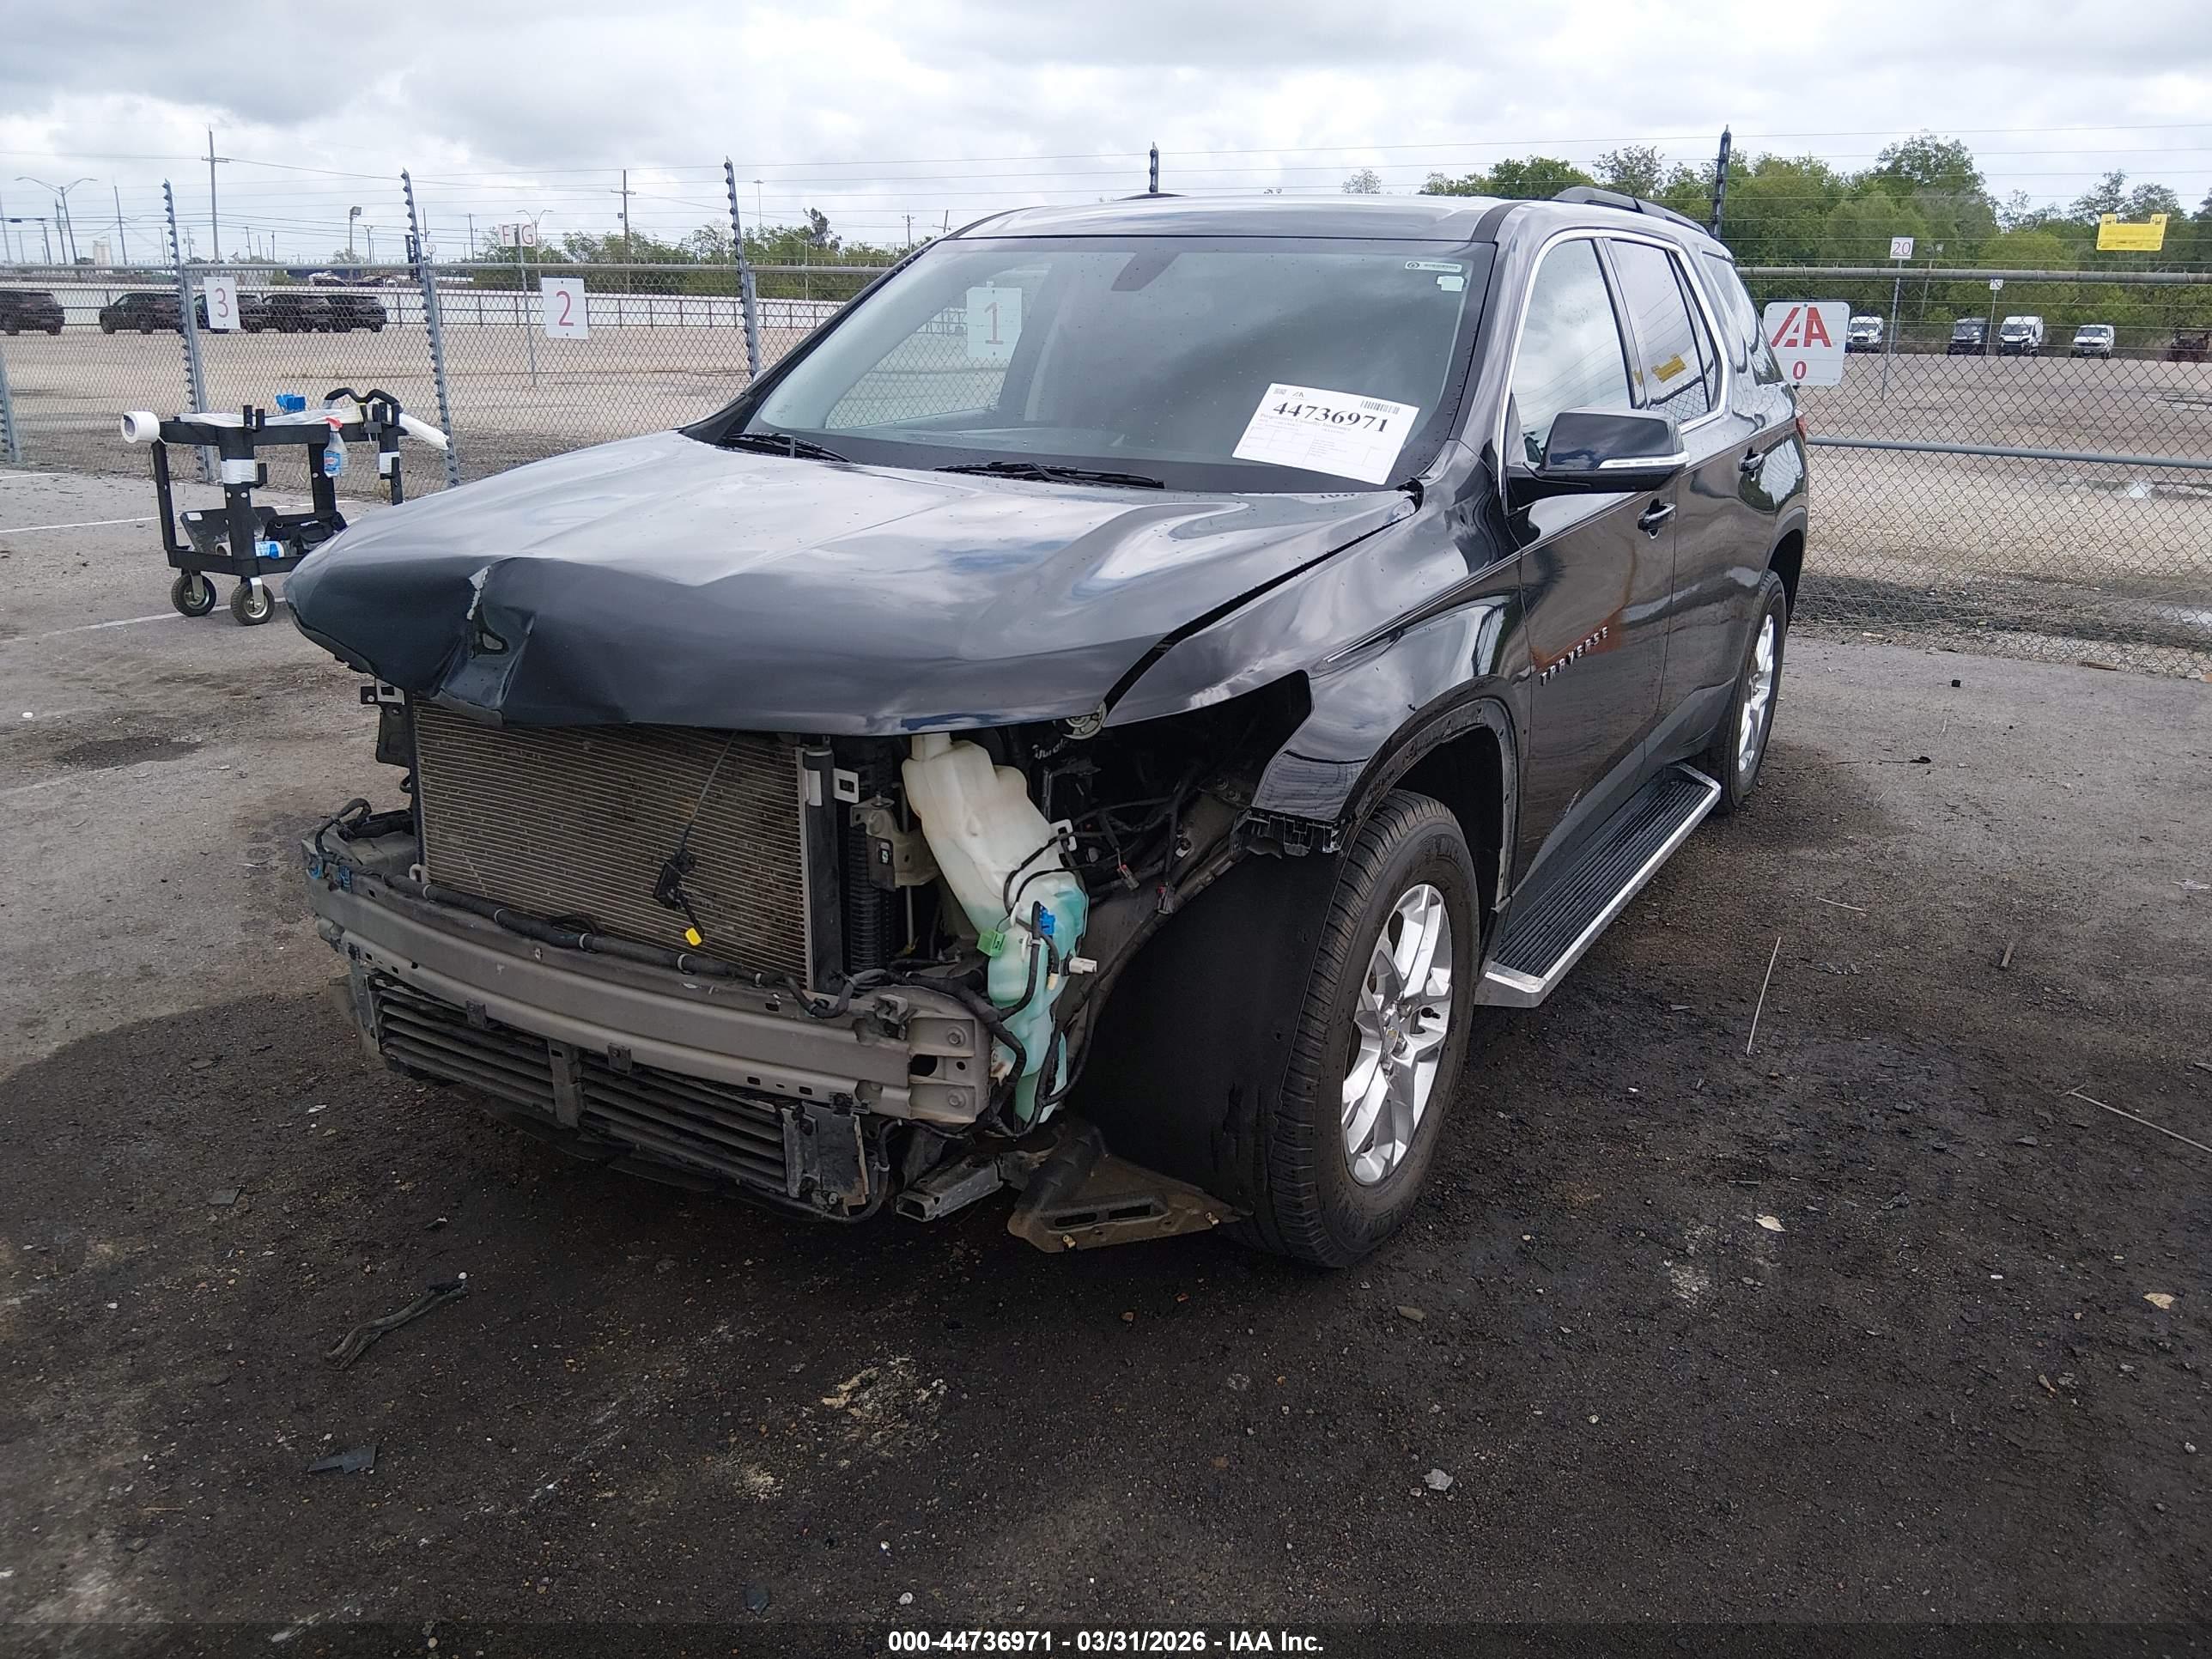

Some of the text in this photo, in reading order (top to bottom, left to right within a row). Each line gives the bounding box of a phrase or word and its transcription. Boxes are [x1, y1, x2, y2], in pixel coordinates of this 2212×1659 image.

[501, 225, 512, 245] F
[521, 225, 534, 246] G
[1892, 241, 1911, 255] 20
[214, 287, 230, 319] 3
[556, 290, 574, 326] 2
[984, 301, 1004, 345] 1
[1792, 361, 1807, 380] 0
[1273, 401, 1389, 433] 44736971
[1539, 626, 1609, 686] TRAVERSE
